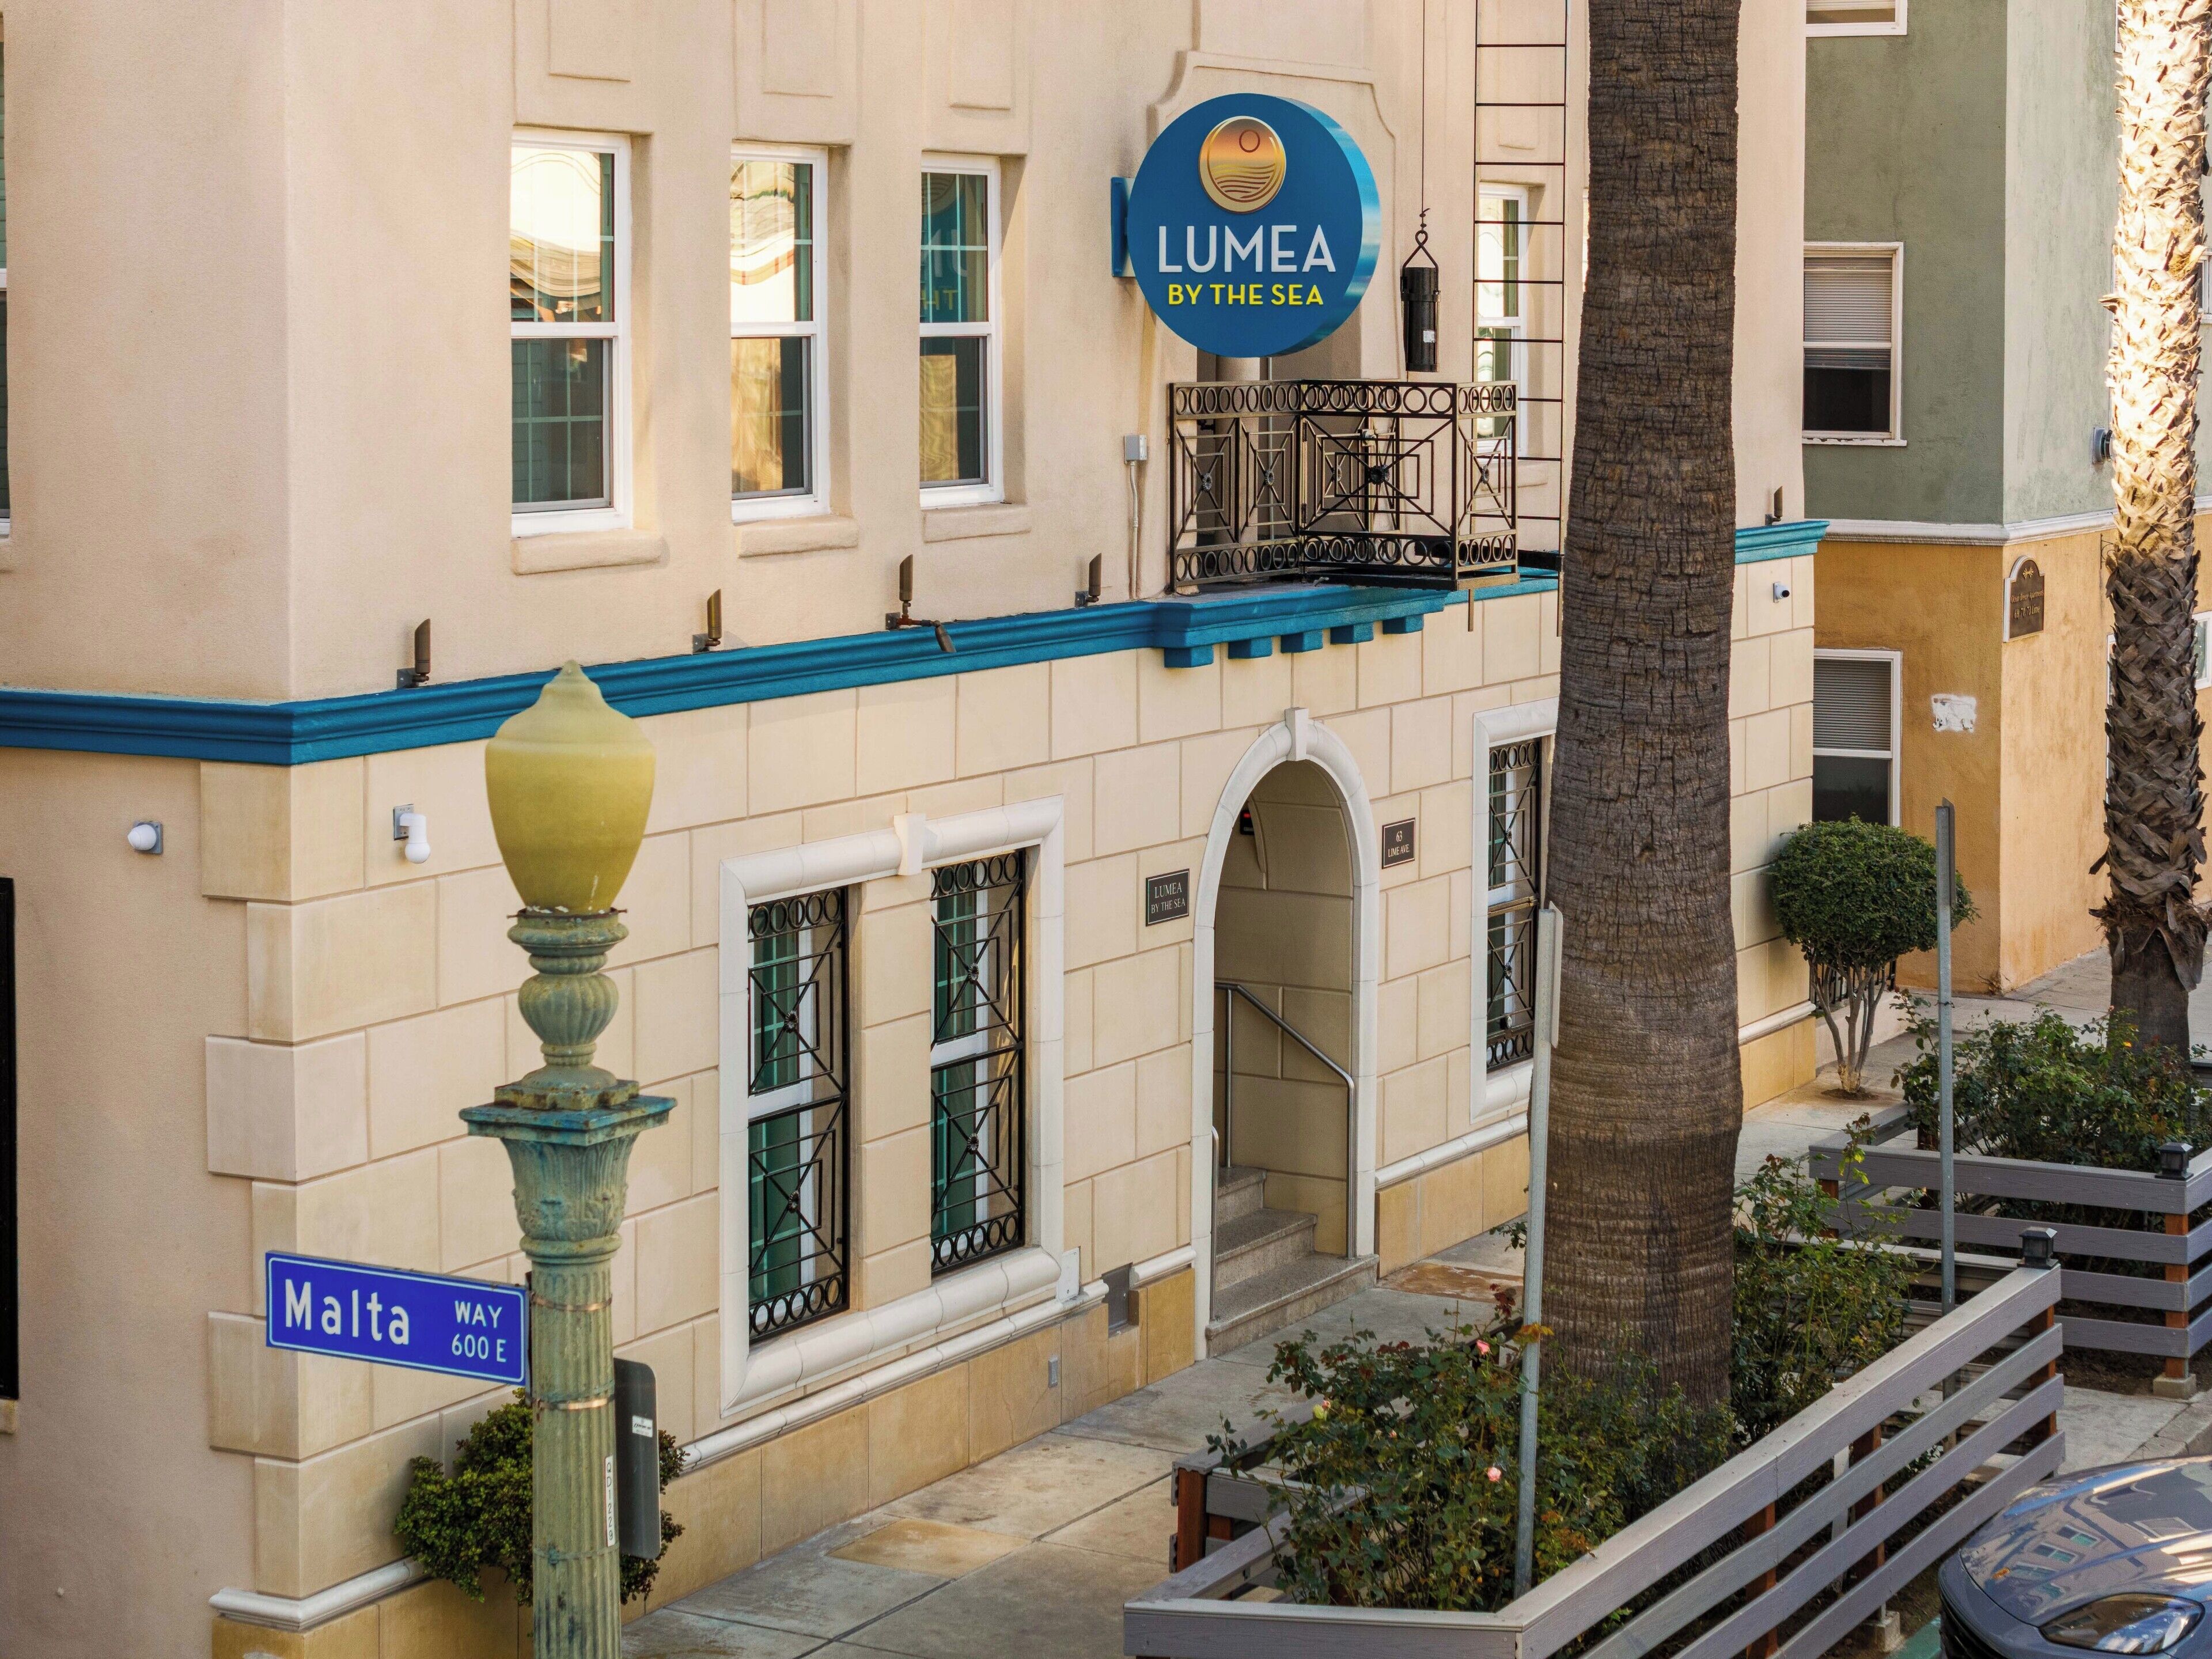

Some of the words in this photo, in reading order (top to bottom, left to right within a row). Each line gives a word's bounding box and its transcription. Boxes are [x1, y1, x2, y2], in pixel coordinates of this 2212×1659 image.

[1158, 225, 1336, 273] LUMEA
[1168, 284, 1202, 305] BY
[1210, 284, 1263, 305] THE
[1271, 284, 1324, 306] SEA
[2032, 604, 2040, 614] Lime
[1396, 831, 1403, 842] 63
[1388, 846, 1399, 857] LIME
[1154, 882, 1181, 897] LUMEA
[1151, 903, 1159, 914] BY
[1161, 900, 1172, 911] THE
[1174, 898, 1185, 908] SEA
[285, 1279, 410, 1345] Malta
[454, 1300, 502, 1328] WAY
[451, 1334, 489, 1359] 600
[496, 1339, 506, 1362] E
